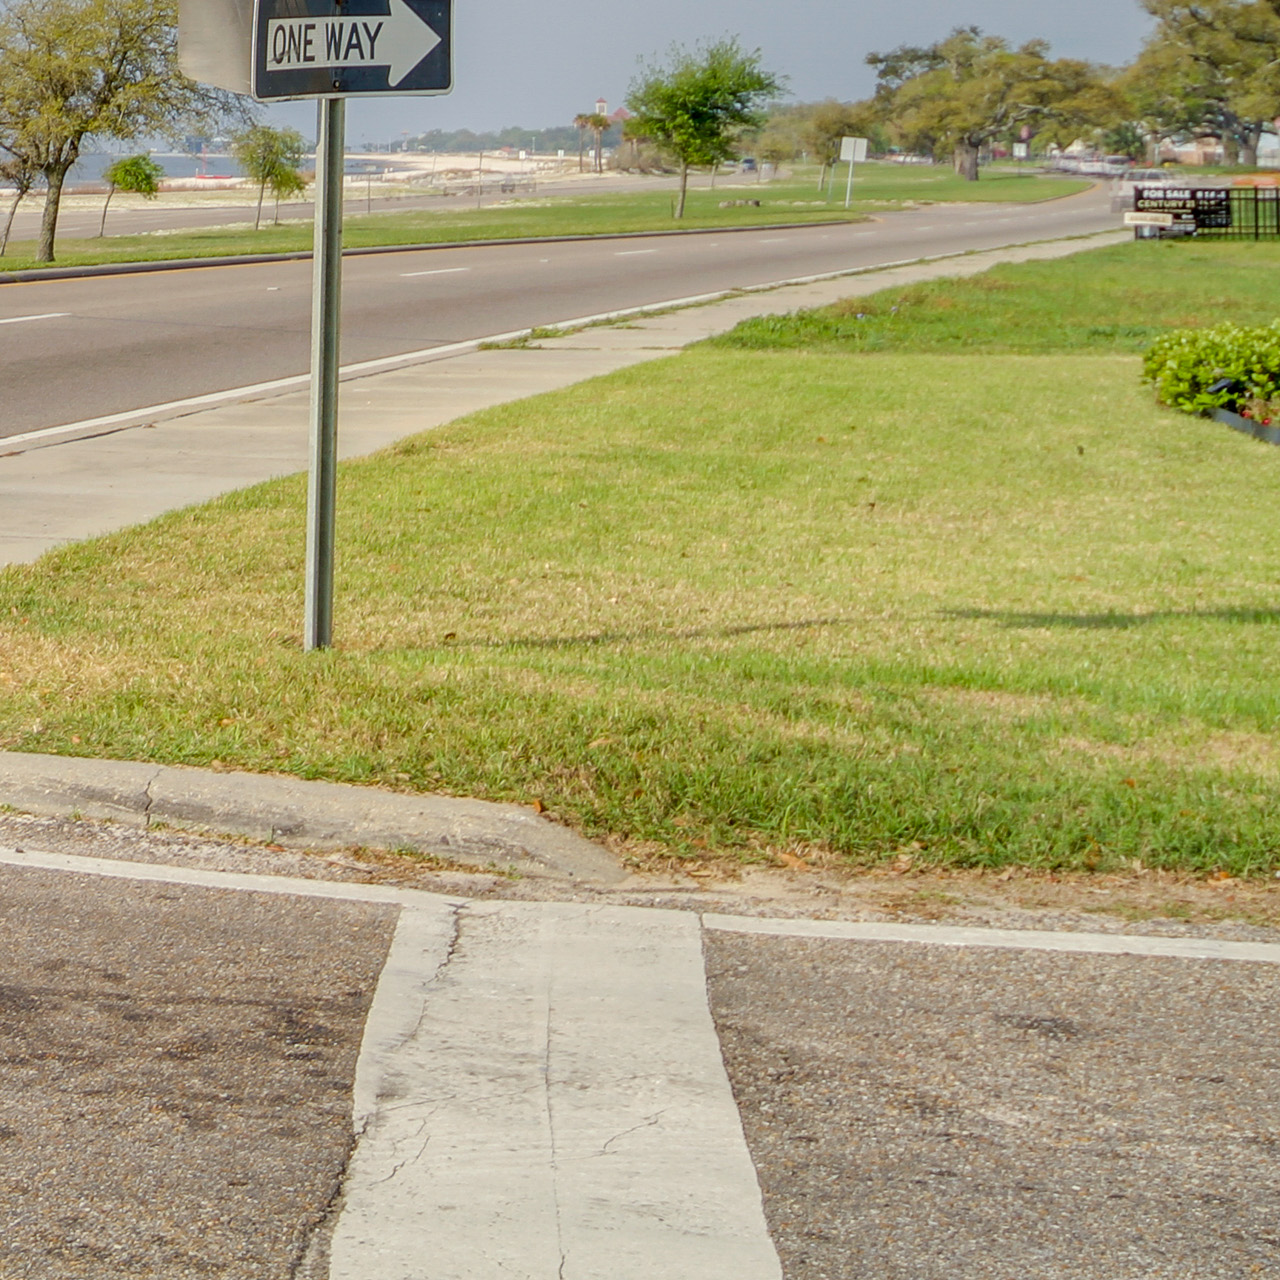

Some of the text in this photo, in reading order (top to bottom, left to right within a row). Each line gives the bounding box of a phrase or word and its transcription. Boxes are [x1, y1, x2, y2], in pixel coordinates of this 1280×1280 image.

[272, 21, 384, 64] ONE WAY
[1143, 190, 1164, 199] FOR
[1166, 190, 1191, 199] SALE
[1137, 200, 1184, 208] CENTURY
[1185, 200, 1195, 208] 21
